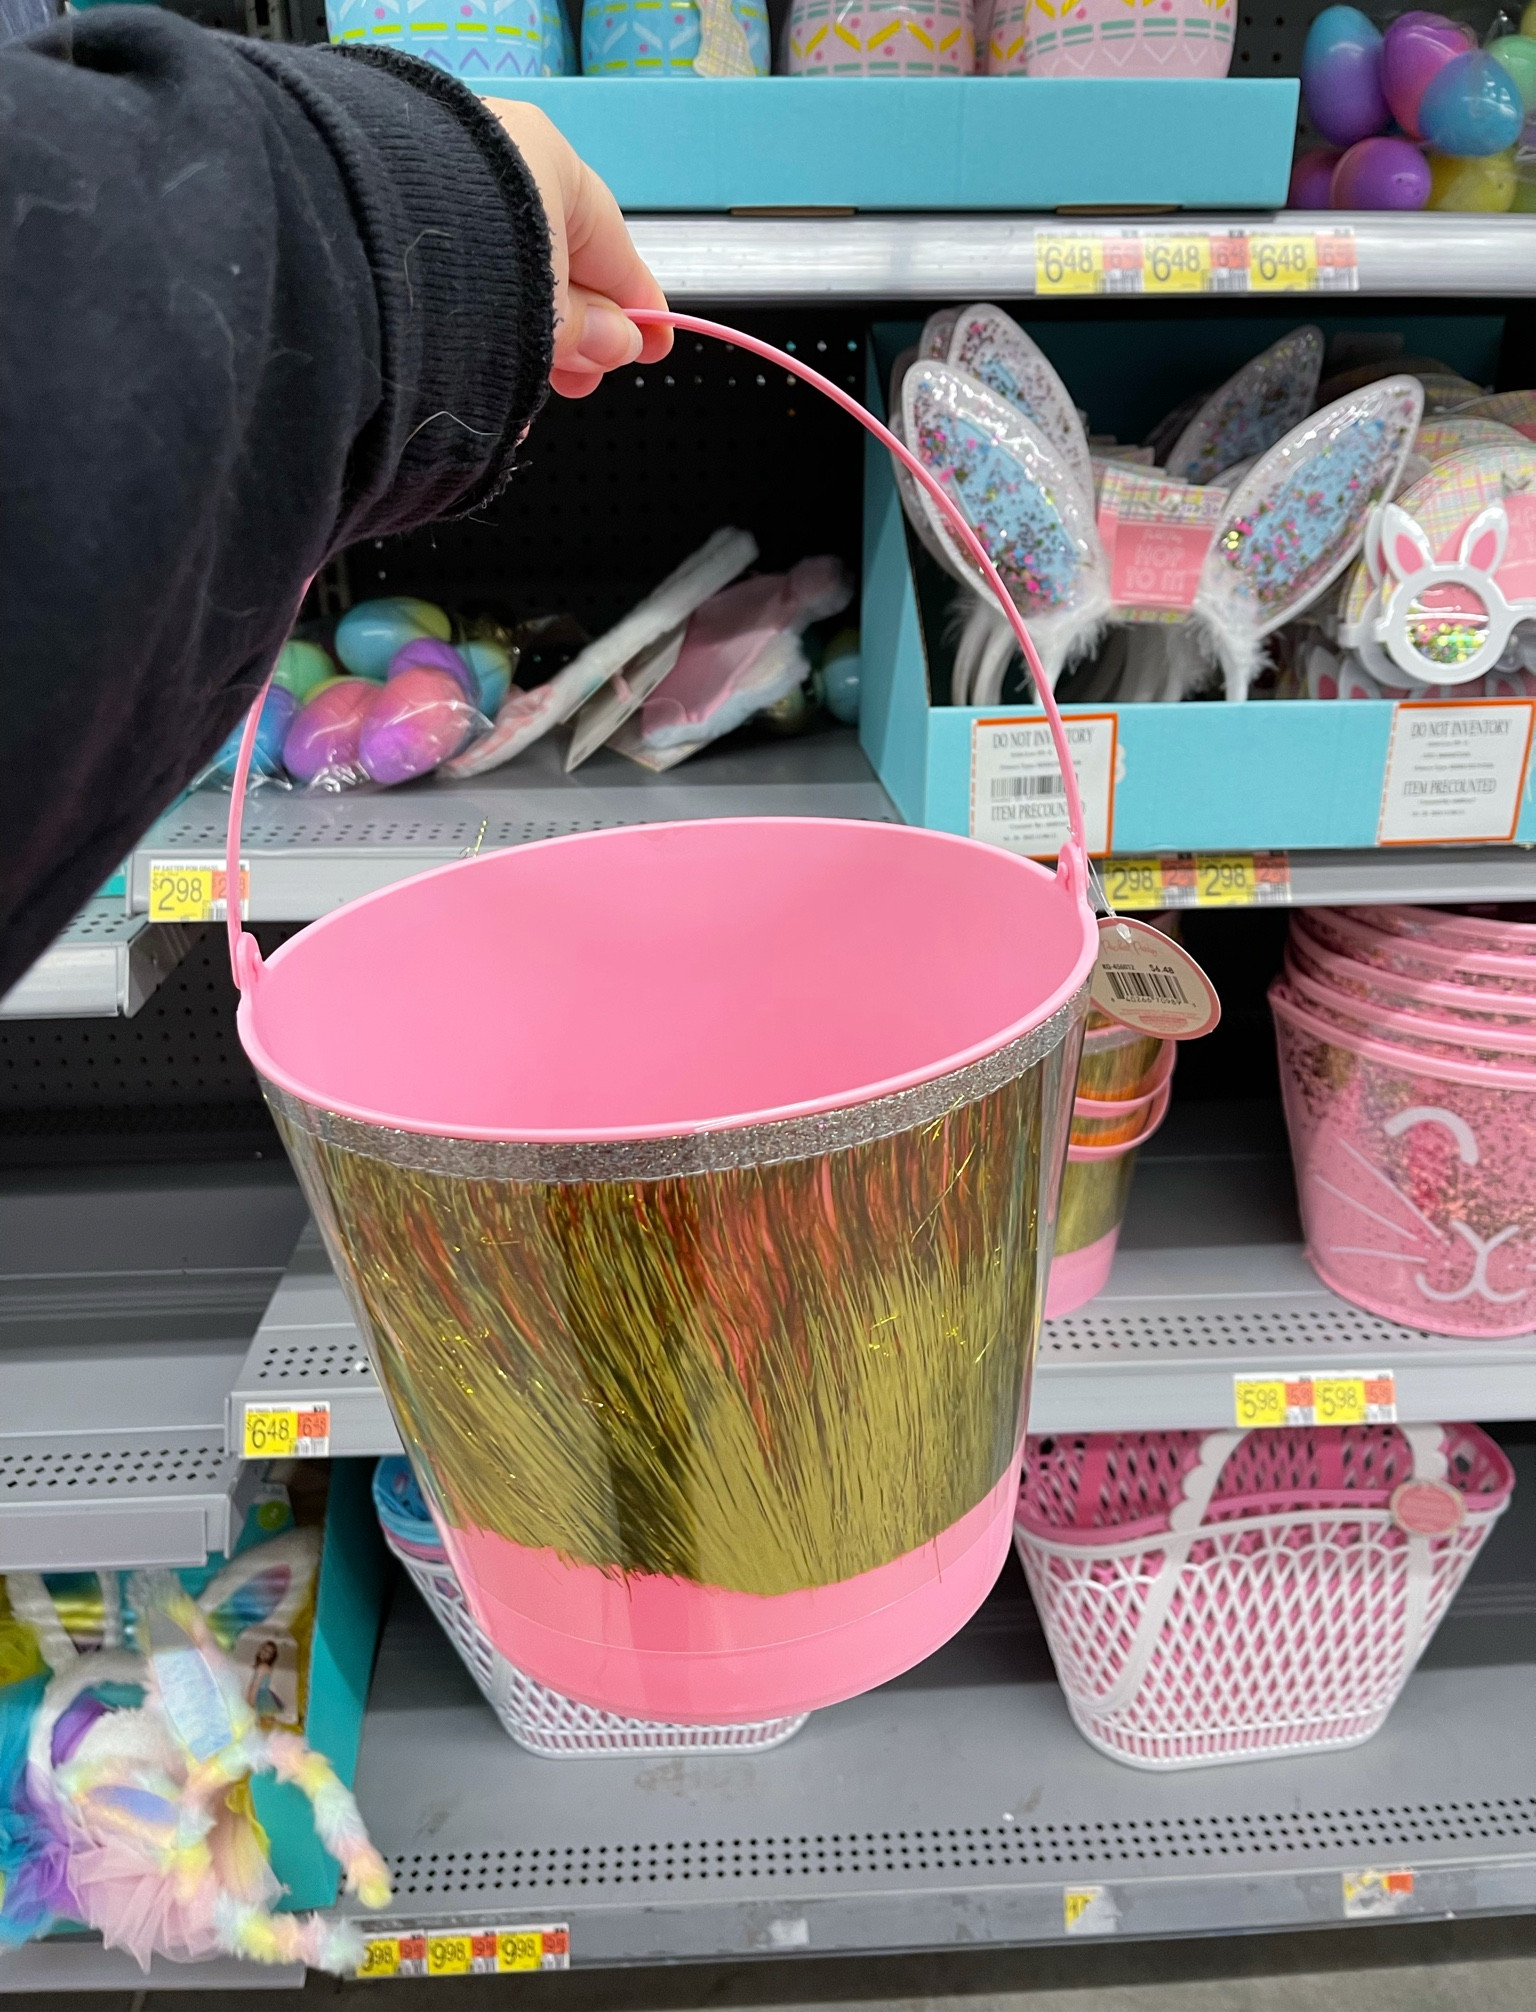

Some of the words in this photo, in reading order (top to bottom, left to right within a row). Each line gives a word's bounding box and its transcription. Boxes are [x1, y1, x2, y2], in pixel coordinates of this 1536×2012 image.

[993, 733, 1008, 748] DO
[1010, 731, 1033, 747] NOT
[1034, 726, 1095, 746] INVTORY
[1411, 721, 1427, 737] DO
[1429, 720, 1449, 737] NOT
[1451, 718, 1512, 737] INVENTORY
[1403, 780, 1427, 796] ITEM
[1430, 777, 1497, 795] PRECOUNTED
[991, 805, 1016, 821] ITEM
[1149, 964, 1175, 974] $6.48
